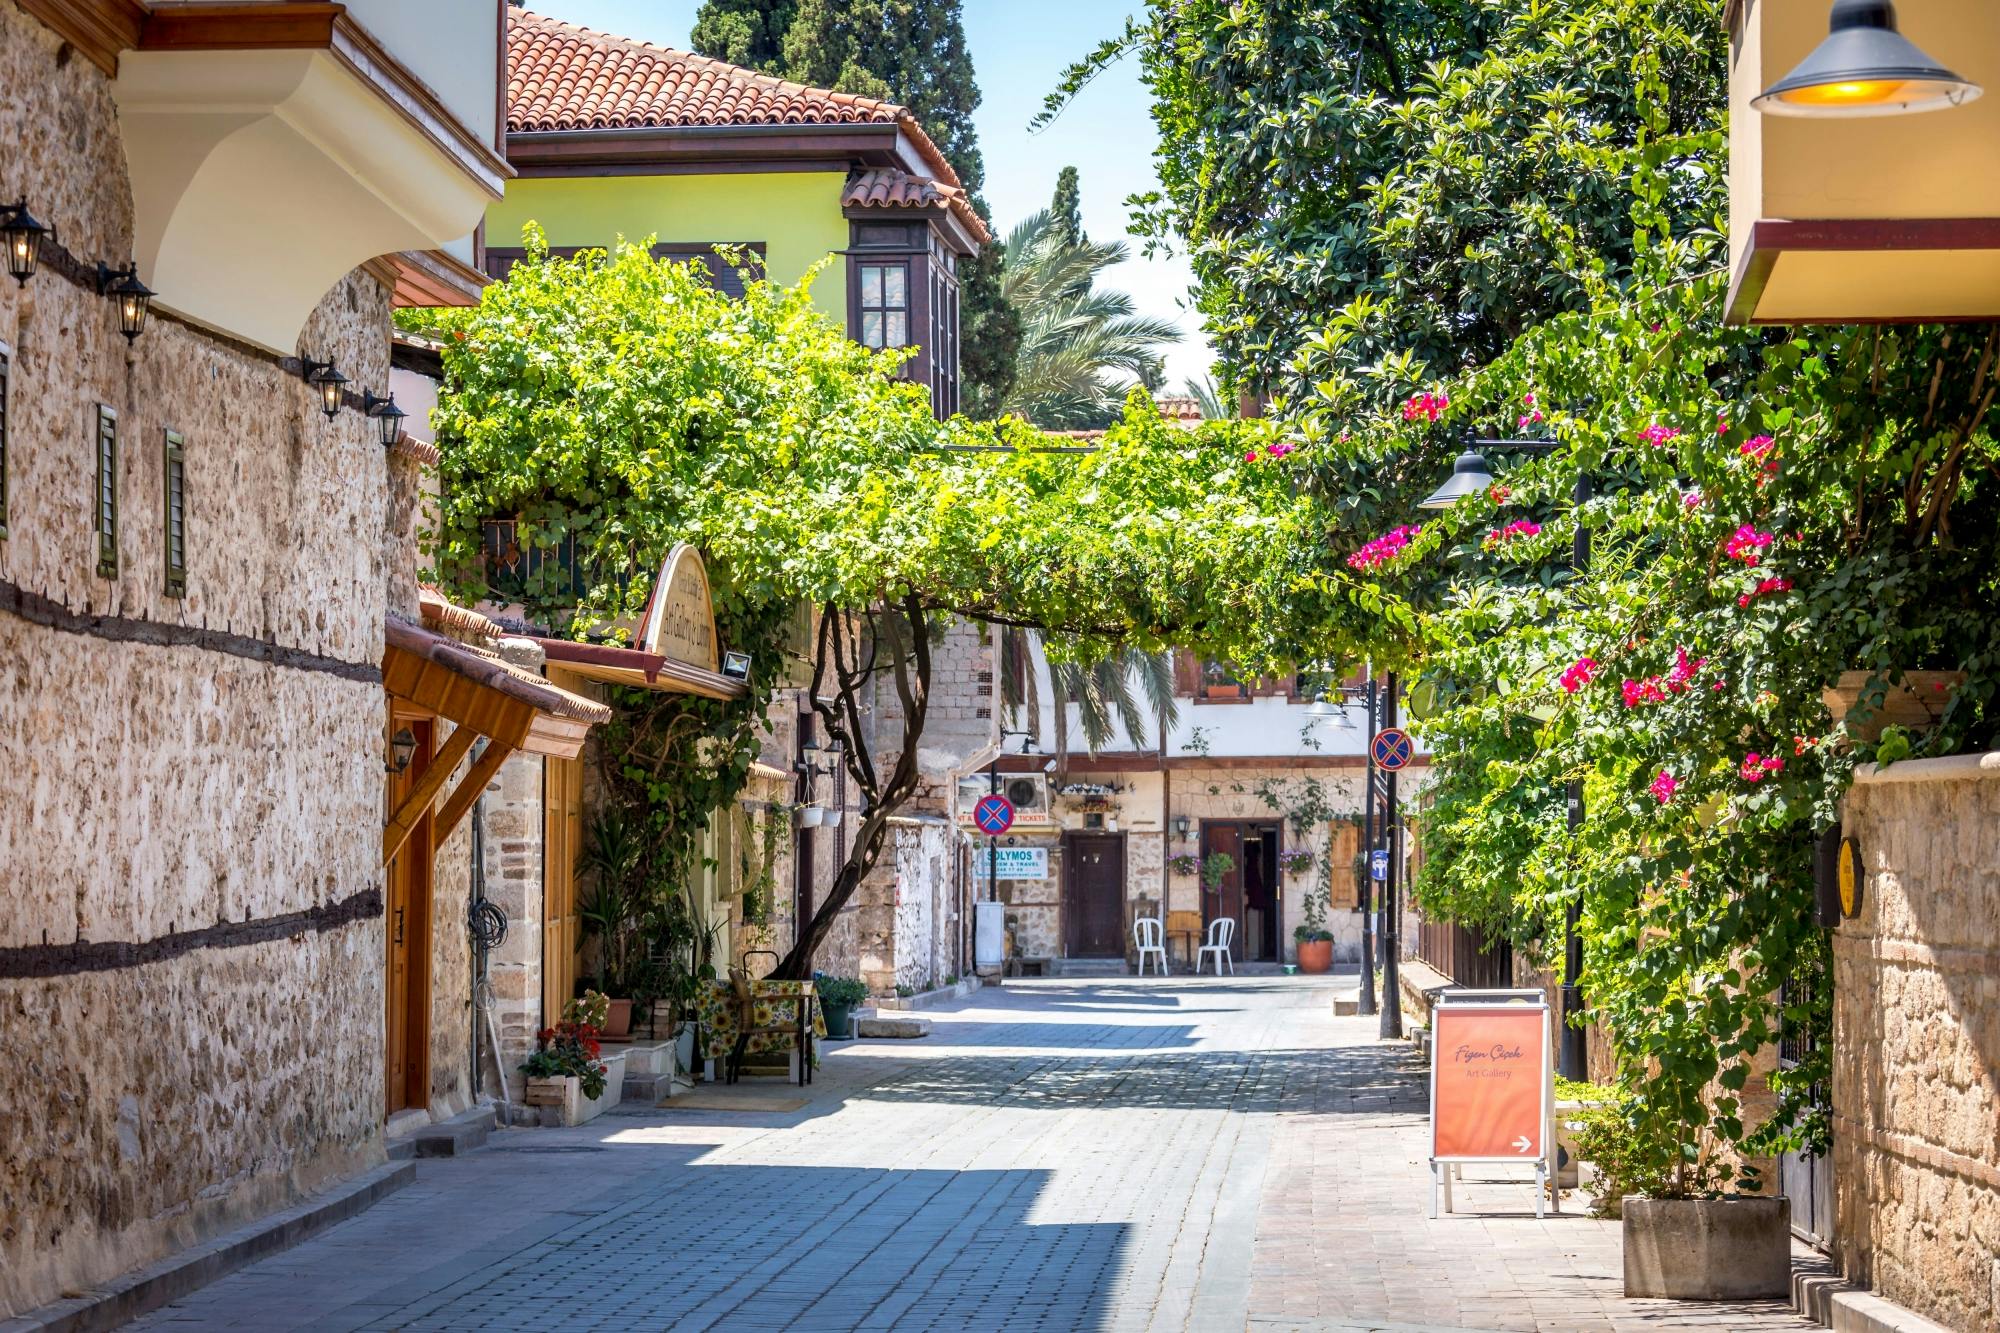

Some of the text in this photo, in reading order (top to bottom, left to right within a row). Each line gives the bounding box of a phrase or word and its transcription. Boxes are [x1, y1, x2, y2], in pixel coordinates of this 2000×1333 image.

[1456, 1045, 1488, 1063] Figen
[1467, 1069, 1512, 1080] Art Gallery
